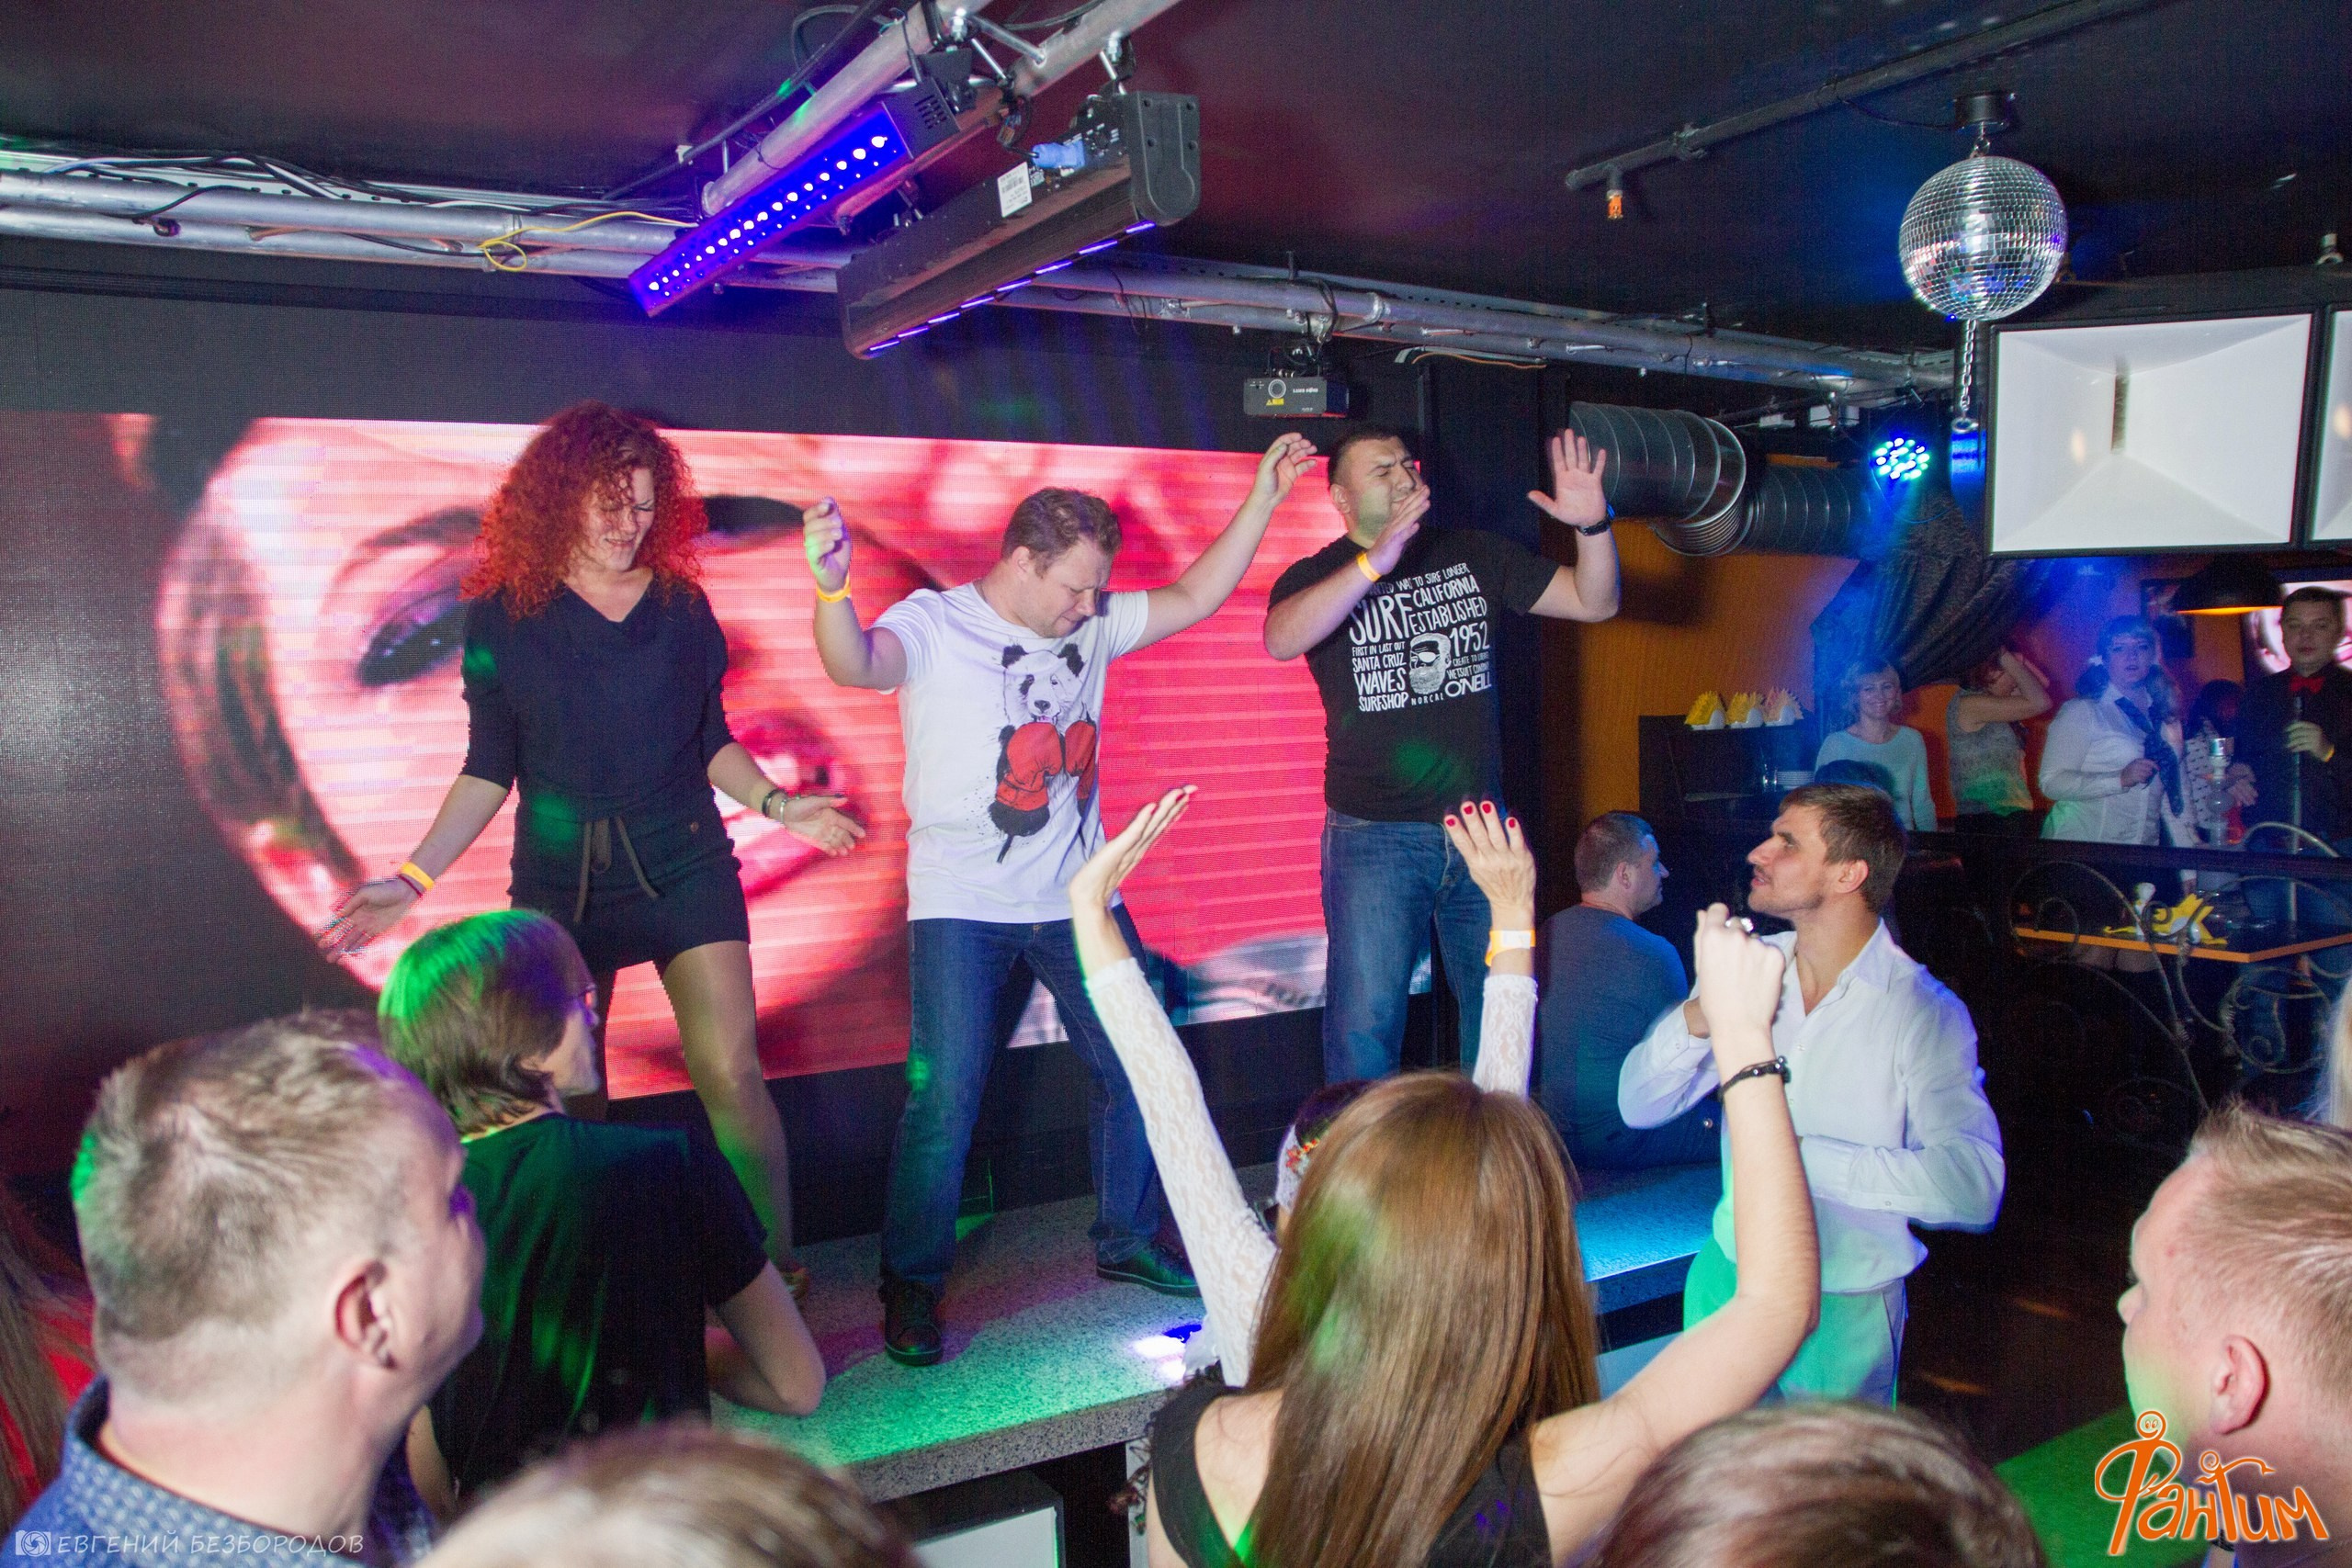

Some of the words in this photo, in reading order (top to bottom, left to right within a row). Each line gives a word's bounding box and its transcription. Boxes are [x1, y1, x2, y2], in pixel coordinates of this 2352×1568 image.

[1412, 576, 1424, 587] TO
[1425, 570, 1442, 584] SURF
[1442, 562, 1470, 580] LONGER
[1413, 574, 1481, 608] CALIFORNIA
[1349, 593, 1413, 646] SURF
[1408, 596, 1487, 636] ESTABLISHED
[1352, 646, 1368, 657] FIRST
[1369, 645, 1377, 656] IN
[1378, 643, 1393, 653] LAST
[1394, 641, 1406, 651] OUT
[1450, 621, 1491, 658] 1952
[1351, 657, 1381, 673] SANTA
[1382, 652, 1407, 668] CRUZ
[1453, 656, 1470, 667] CREATE
[1471, 654, 1478, 662] TO
[1353, 667, 1407, 695] WAVES
[1446, 665, 1473, 680] WETSUIT
[1359, 692, 1408, 712] SURFSHOP
[1411, 693, 1444, 705] NORCAL
